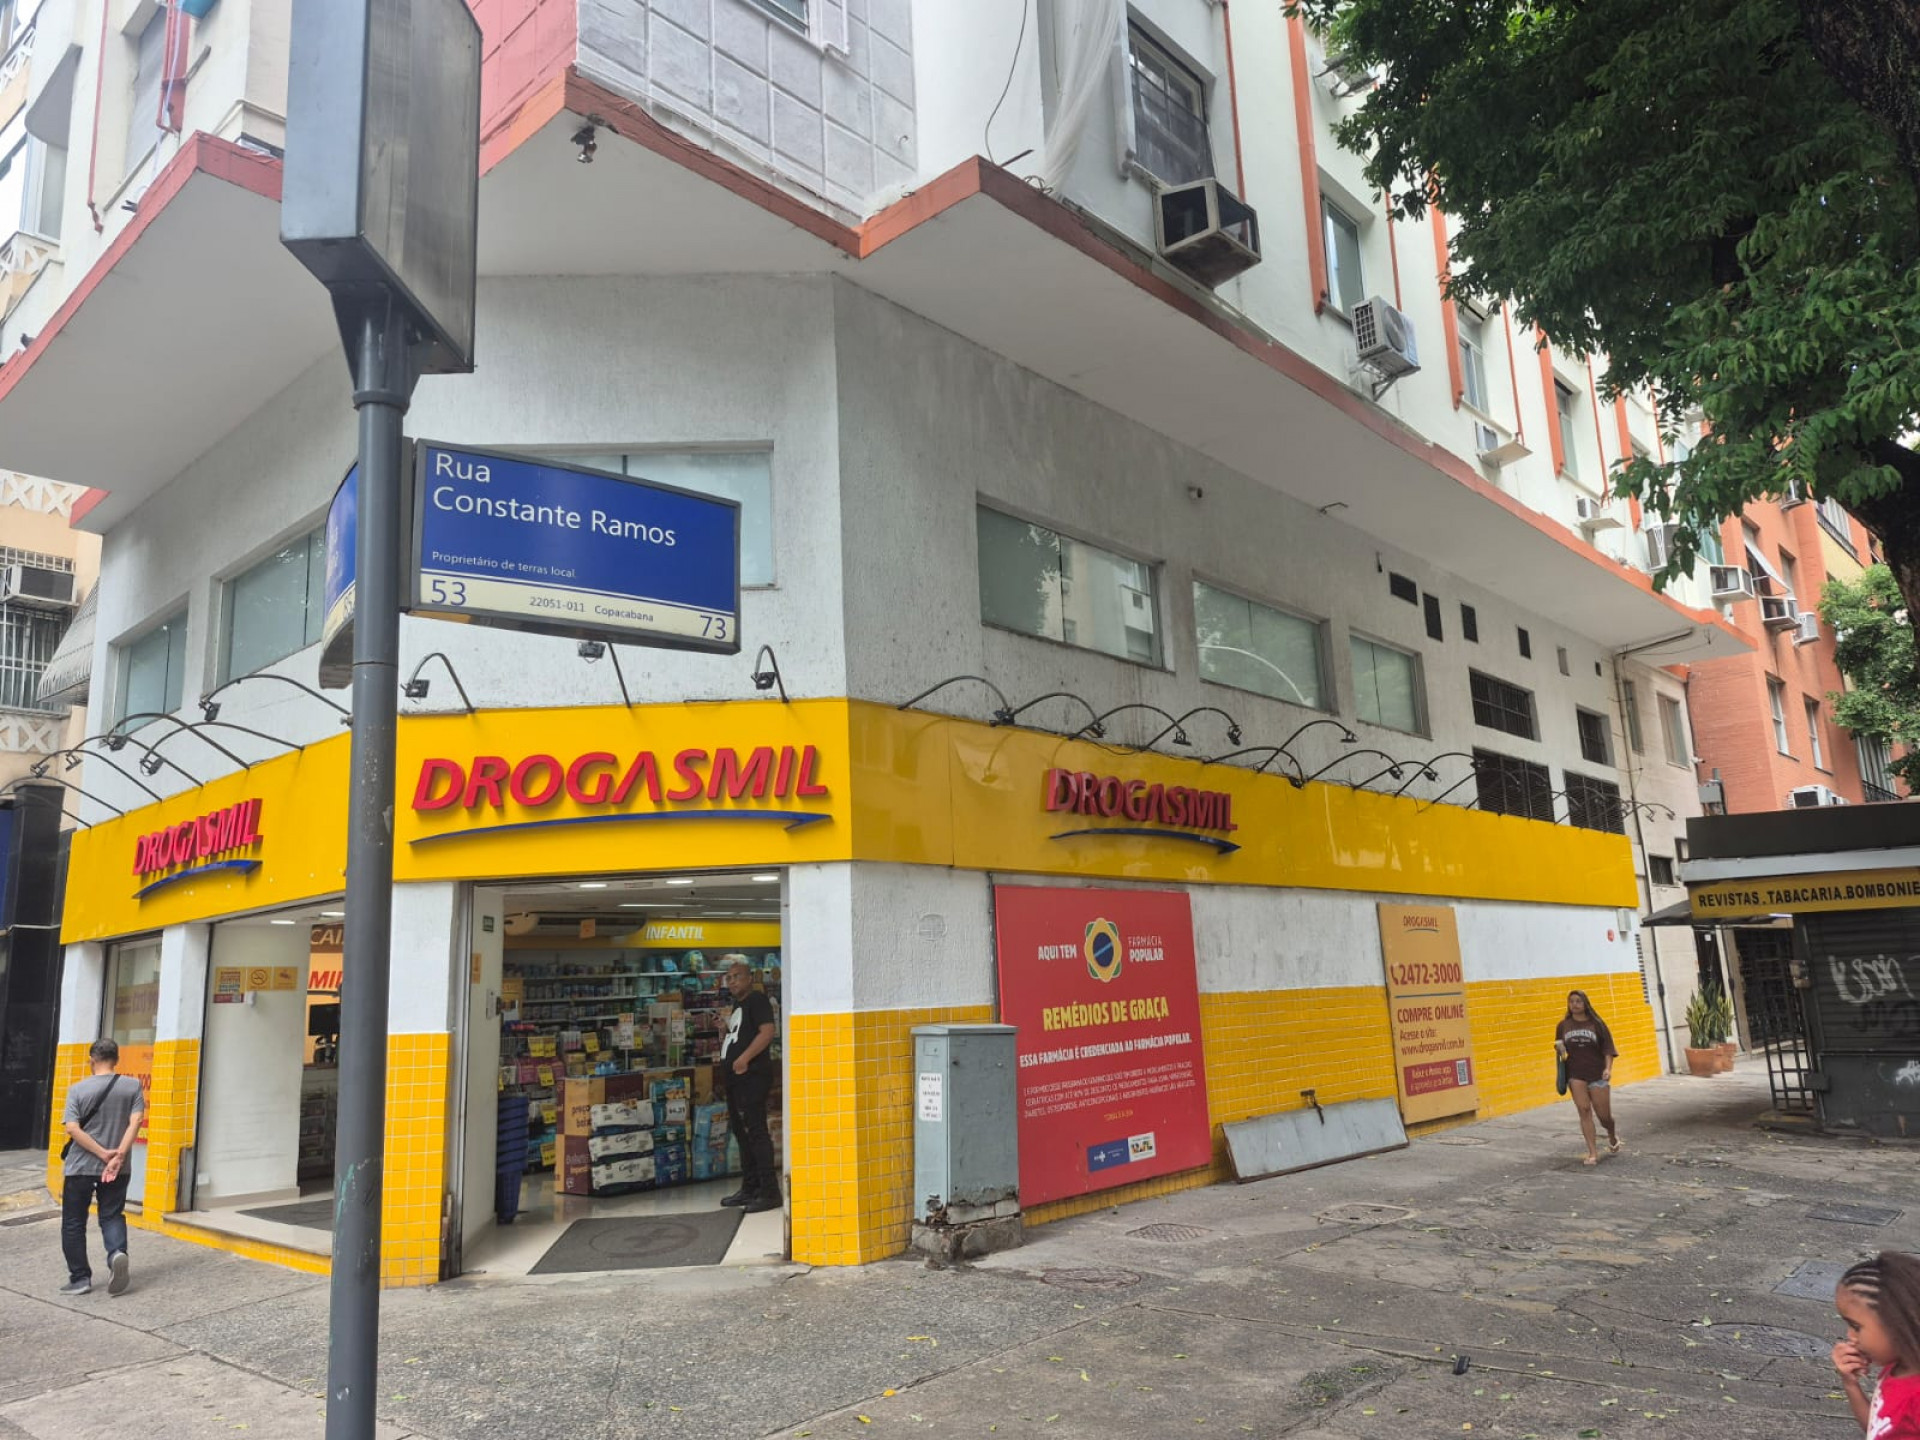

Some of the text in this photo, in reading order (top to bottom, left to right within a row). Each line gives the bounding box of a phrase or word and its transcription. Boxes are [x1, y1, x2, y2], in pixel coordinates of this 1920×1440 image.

[435, 453, 491, 483] Rua
[433, 485, 676, 547] Constante Ramos
[432, 551, 499, 569] Proprietário
[501, 559, 515, 571] de
[518, 563, 548, 575] terras
[431, 579, 467, 606] 53
[529, 596, 654, 623] 22051-011 Copacabana
[699, 614, 727, 640] 73
[412, 745, 828, 811] DROGASMIL
[1046, 768, 1238, 831] DROGASMIL
[133, 798, 263, 876] DROGASMIL
[310, 929, 343, 946] CAI
[646, 926, 704, 941] INFANTIL
[1037, 944, 1077, 961] AQUI TEM
[1130, 948, 1164, 963] POPULAR
[1400, 962, 1461, 985] 2472-3000
[1043, 996, 1169, 1031] REMÉDIOS DE GRAÇA
[1397, 1004, 1465, 1024] COMPRE ONLINE
[1020, 1054, 1038, 1067] ESSA
[1039, 1047, 1074, 1064] FARMÁCIA
[1080, 1041, 1123, 1058] CREDENCIADA
[1134, 1034, 1164, 1050] FARMÁCIA
